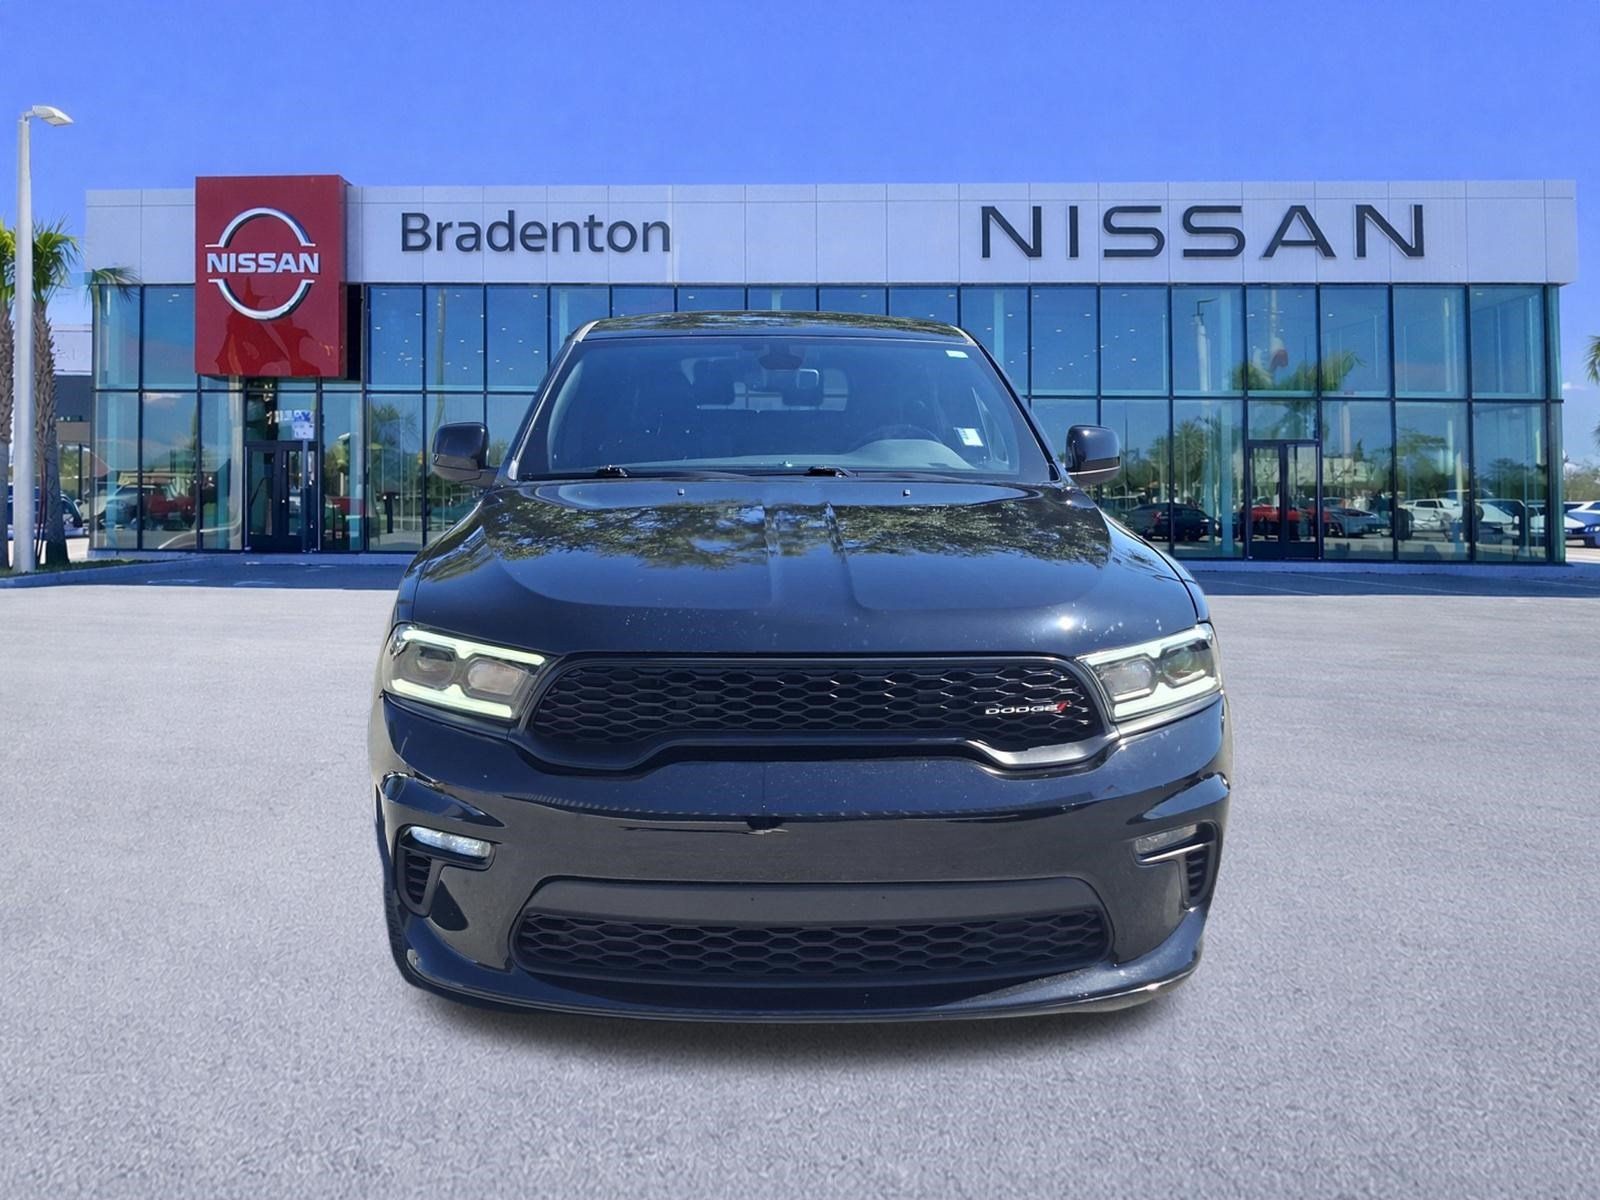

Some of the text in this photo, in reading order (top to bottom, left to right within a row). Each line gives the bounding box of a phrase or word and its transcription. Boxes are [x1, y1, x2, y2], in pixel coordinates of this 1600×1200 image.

[401, 209, 671, 253] Bradenton
[980, 204, 1425, 259] NISSAN
[206, 252, 319, 273] NISSAN
[984, 703, 1061, 715] DODGE
